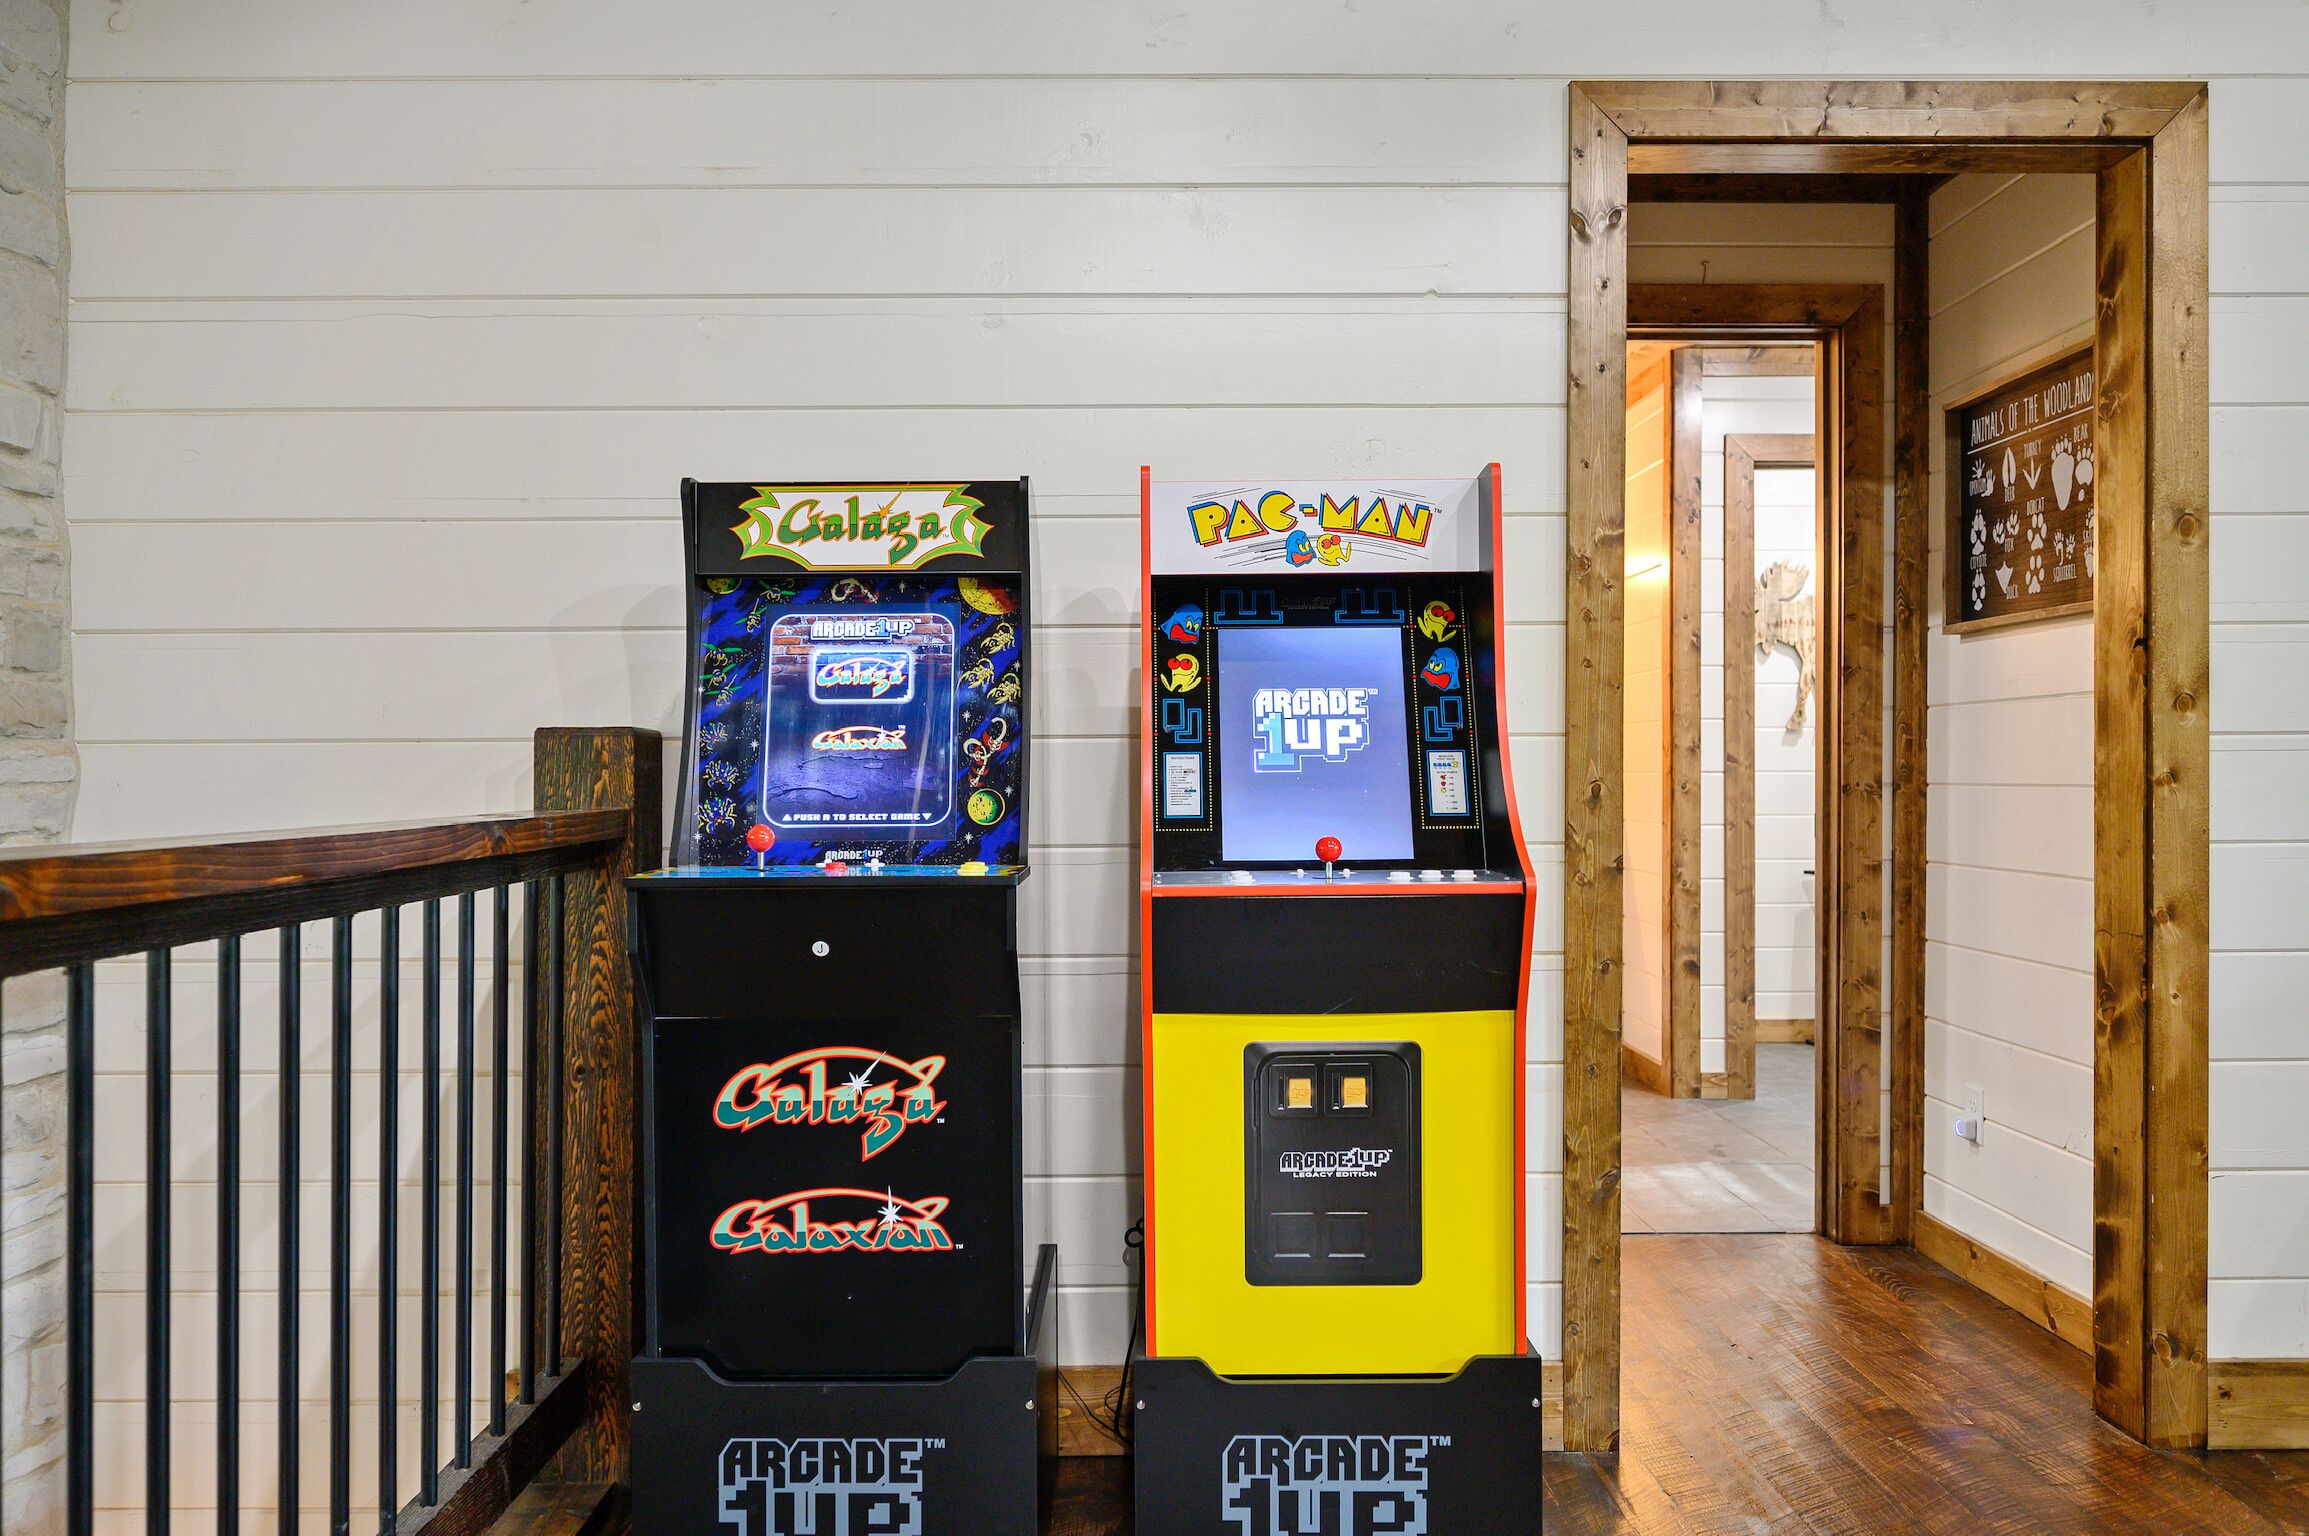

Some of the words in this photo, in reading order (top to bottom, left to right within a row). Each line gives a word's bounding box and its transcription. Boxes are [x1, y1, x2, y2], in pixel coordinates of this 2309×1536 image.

[1971, 408, 2005, 447] ANIMALS
[2008, 402, 2019, 432] OF
[2023, 394, 2039, 426] THE
[2073, 423, 2089, 443] BEAR
[2023, 439, 2042, 459] TURKEY
[775, 495, 946, 567] Galaga
[1186, 490, 1434, 548] PAC-MAN
[2053, 563, 2077, 583] SQUIRREL
[816, 657, 907, 699] Galaga
[1254, 688, 1368, 719] ARCADE
[811, 726, 908, 751] Galaxian
[1255, 712, 1366, 768] 1UP
[793, 813, 816, 821] PUSH
[822, 813, 831, 821] A
[832, 813, 847, 821] TO
[848, 813, 889, 821] SELECT
[890, 812, 921, 821] GAME
[712, 1045, 947, 1162] Galaga
[1293, 1171, 1334, 1179] LEGACY
[1335, 1171, 1378, 1179] EDITION
[709, 1187, 955, 1256] Galaxian
[718, 1438, 923, 1490] ARCADE
[1222, 1435, 1428, 1488] ARCADE
